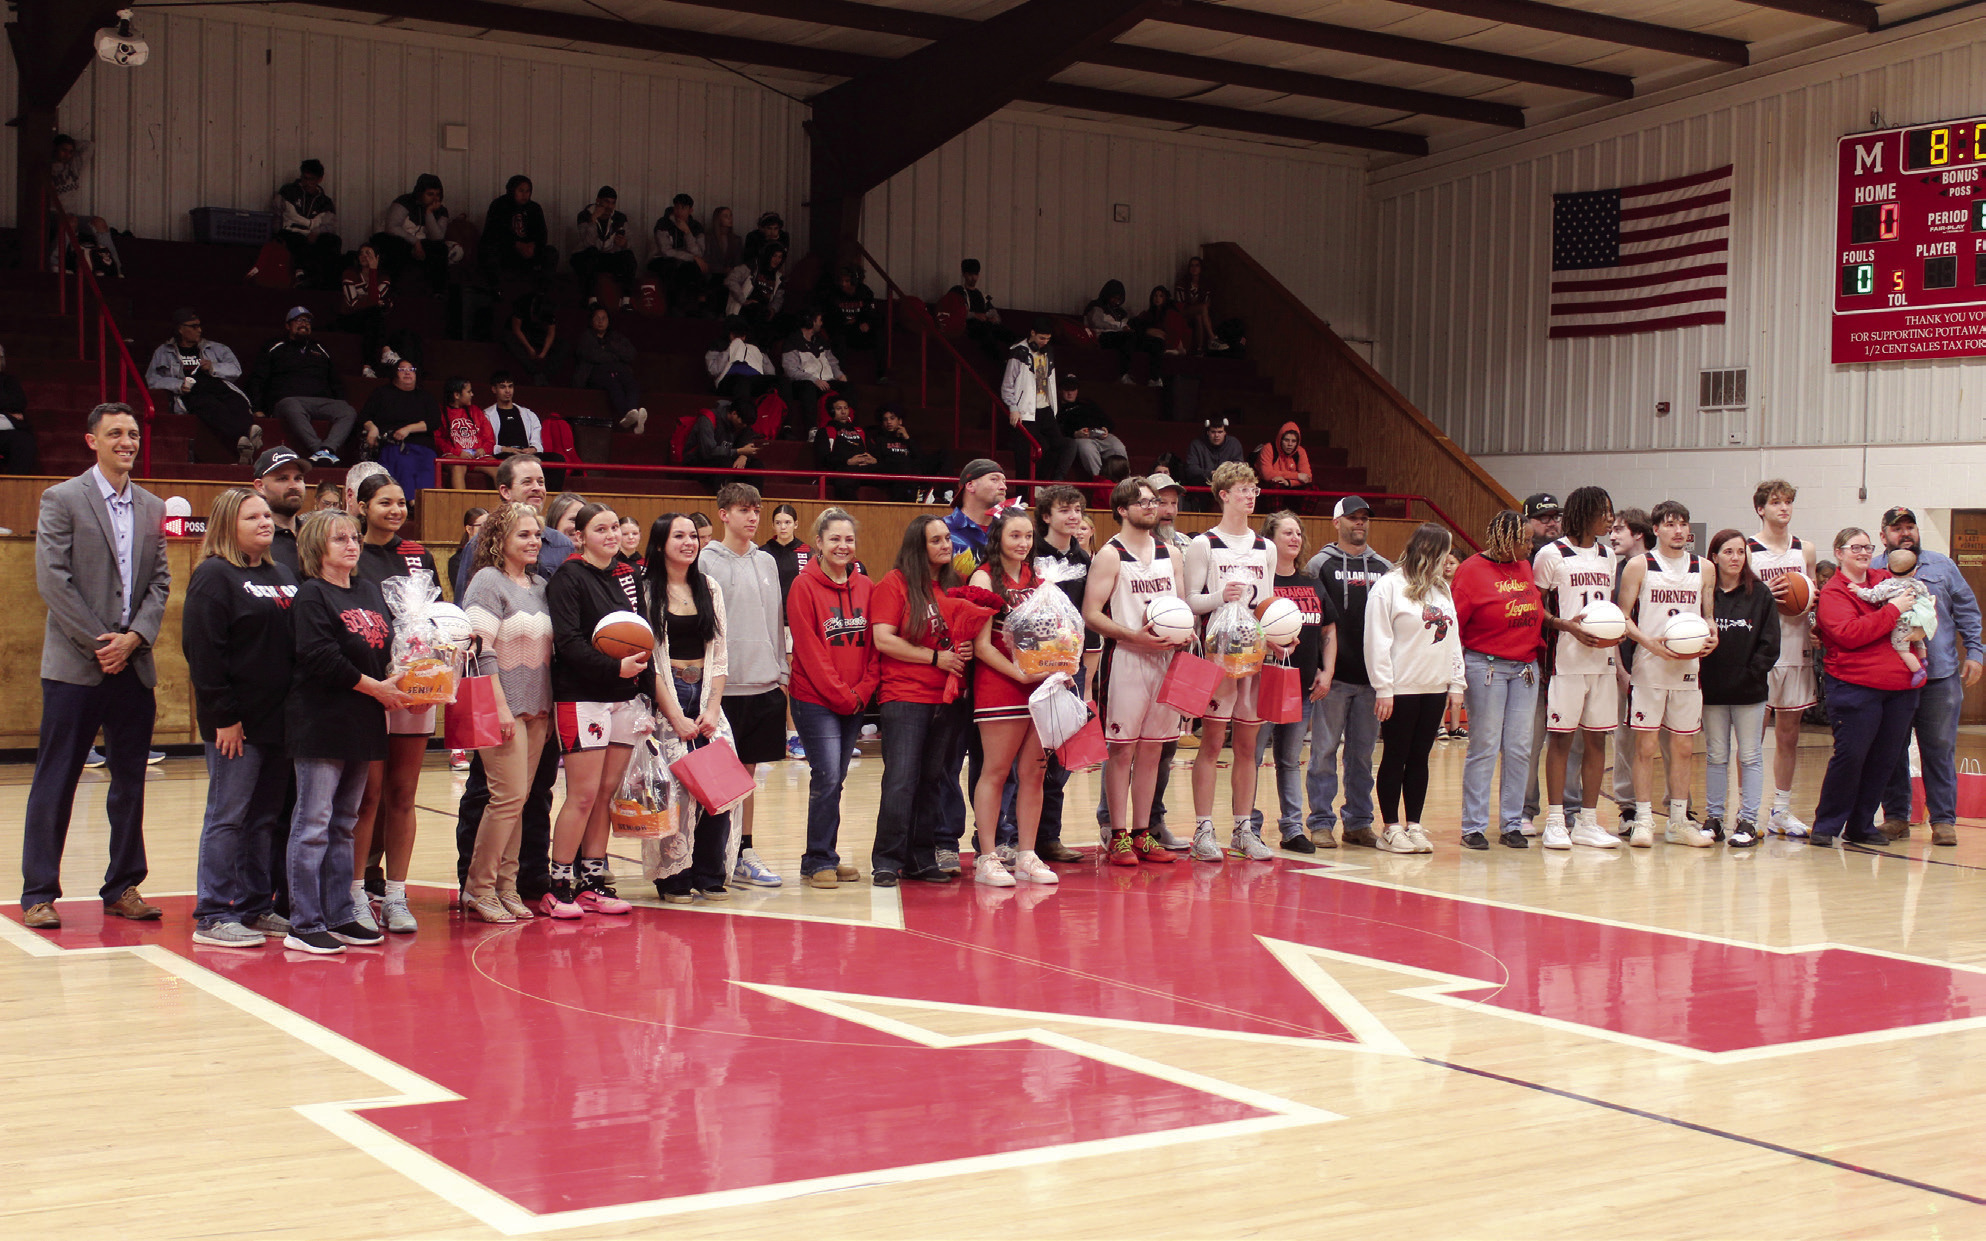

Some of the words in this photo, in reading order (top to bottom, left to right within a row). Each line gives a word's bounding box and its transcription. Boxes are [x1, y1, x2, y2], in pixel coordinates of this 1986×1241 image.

[1854, 141, 1883, 175] M
[1942, 168, 1979, 184] BONUS
[1855, 183, 1896, 202] HOME
[1949, 186, 1971, 196] POSS
[1880, 204, 1898, 239] 0
[1928, 210, 1968, 225] PERIOD
[1843, 249, 1875, 263] FOULS
[1916, 241, 1957, 257] PLAYER
[1857, 265, 1872, 293] 0
[1893, 271, 1903, 290] 5
[1888, 294, 1907, 306] TOL
[1905, 314, 1942, 325] THANK
[1944, 313, 1966, 322] YOU
[1969, 311, 1986, 321] VO
[1851, 332, 1869, 342] FOR
[1871, 328, 1933, 341] SUPPORTING
[1865, 345, 1880, 356] 1/2
[1882, 343, 1908, 353] CENT
[1910, 341, 1940, 352] SALES
[1942, 340, 1963, 350] TAX
[184, 521, 207, 533] POSS.
[1334, 570, 1382, 581] OLAHMA
[1570, 572, 1611, 587] HORNETS
[1650, 589, 1698, 604] HORNETS
[1293, 598, 1320, 611] TTA
[1505, 600, 1537, 617] Legend
[340, 608, 389, 633] SENIOR
[1301, 613, 1321, 624] OMB
